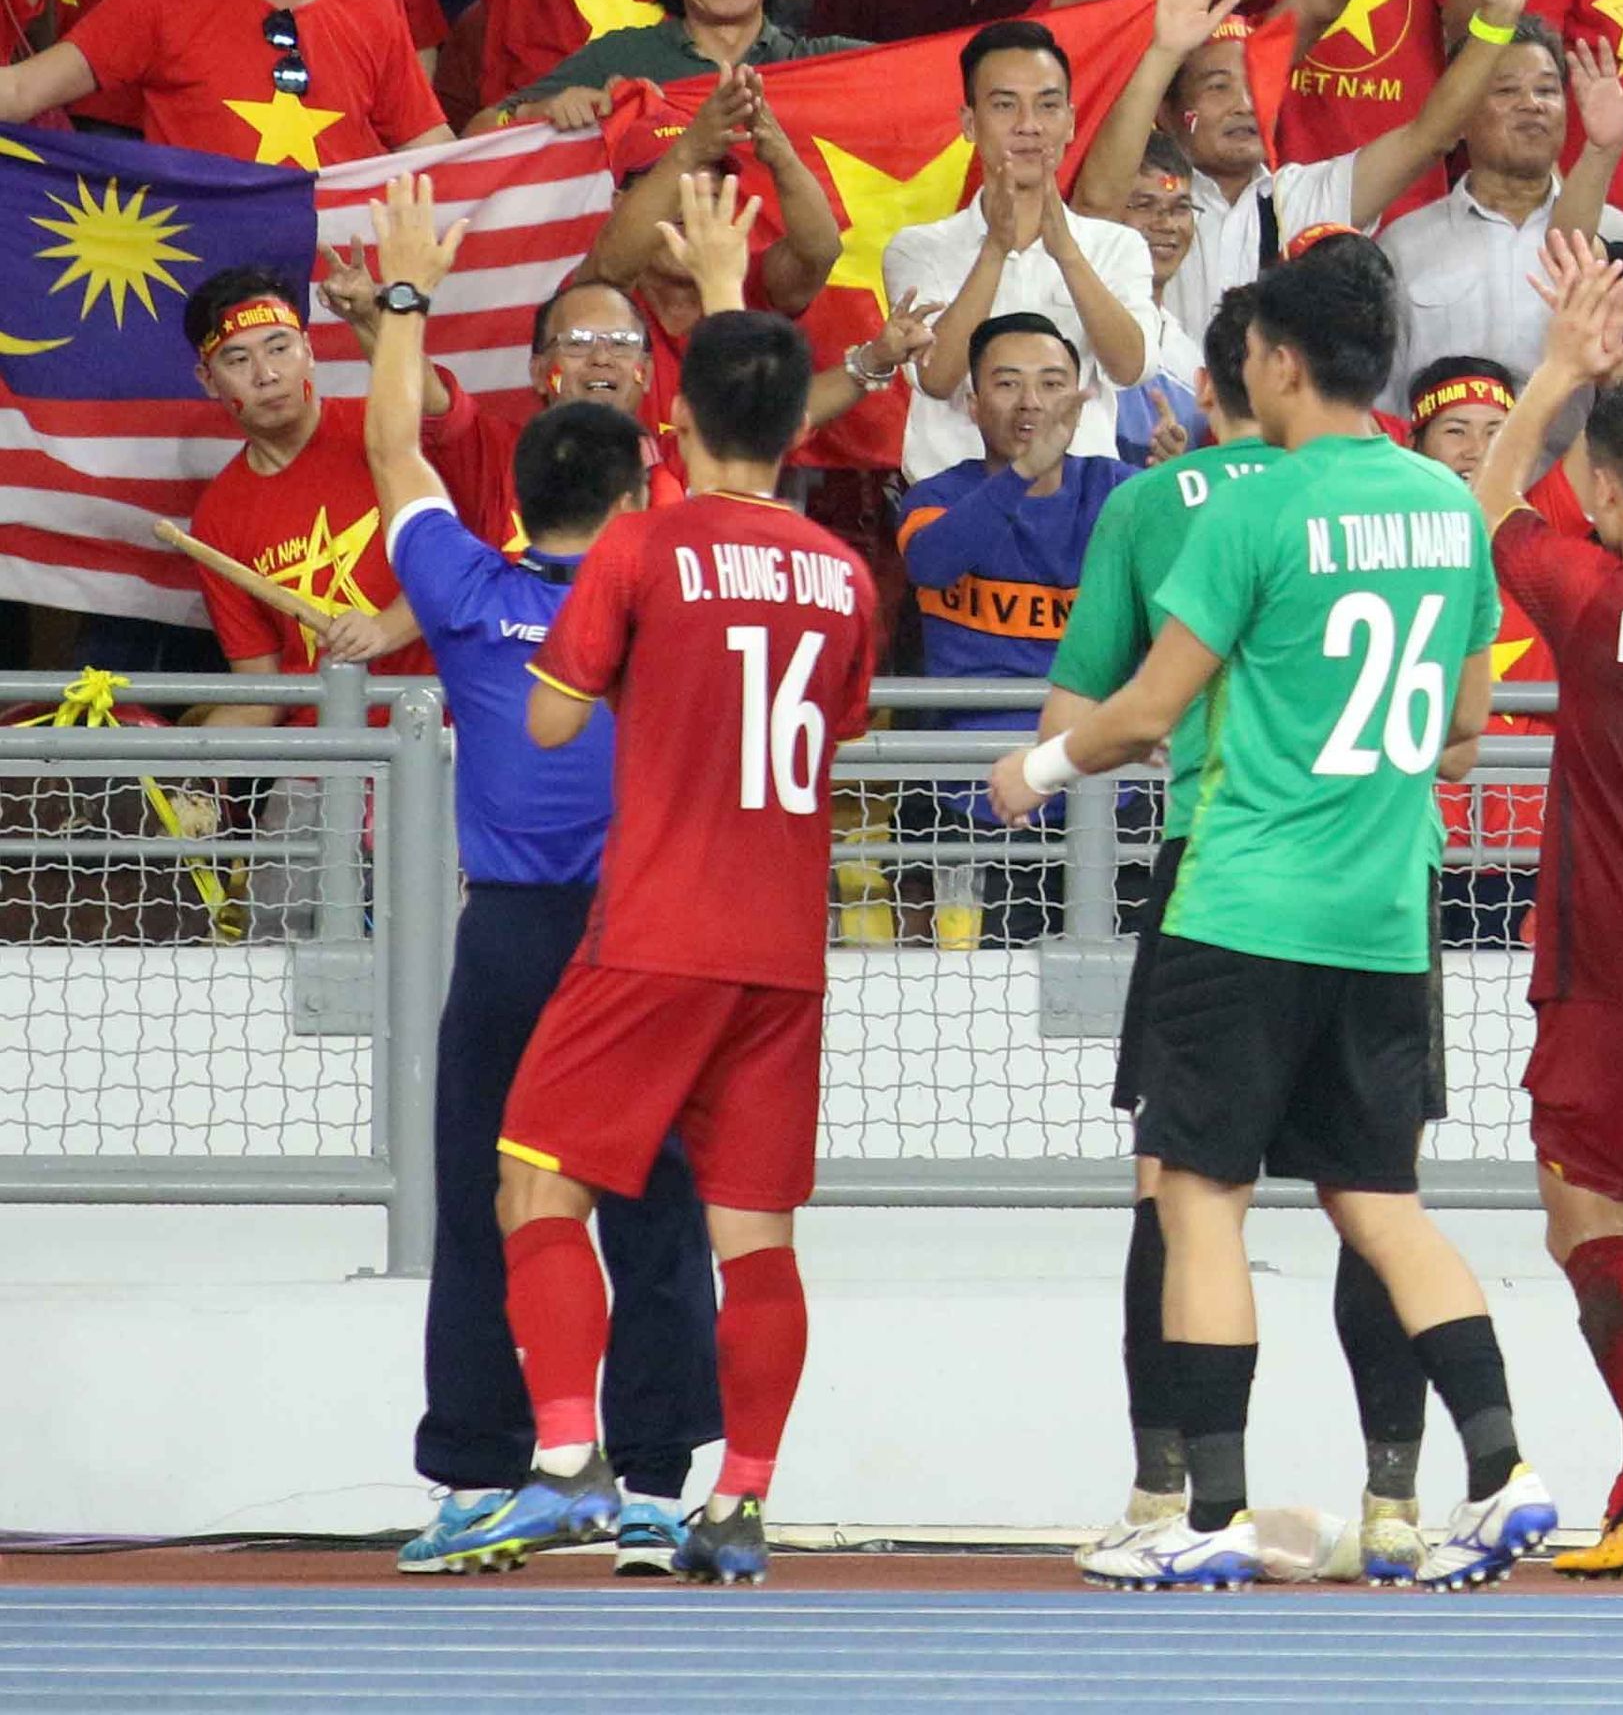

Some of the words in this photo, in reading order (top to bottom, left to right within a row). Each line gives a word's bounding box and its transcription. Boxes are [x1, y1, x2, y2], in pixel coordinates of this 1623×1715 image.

[1291, 68, 1331, 97] IỆT
[1438, 383, 1467, 407] NAM
[1307, 516, 1338, 575] N.
[1340, 512, 1407, 574] TUAN
[1409, 510, 1473, 571] MANH
[675, 545, 713, 603] D.
[713, 542, 785, 603] HUNG
[791, 549, 856, 618] DUNG
[1310, 590, 1446, 777] 26
[725, 625, 828, 815] 16
